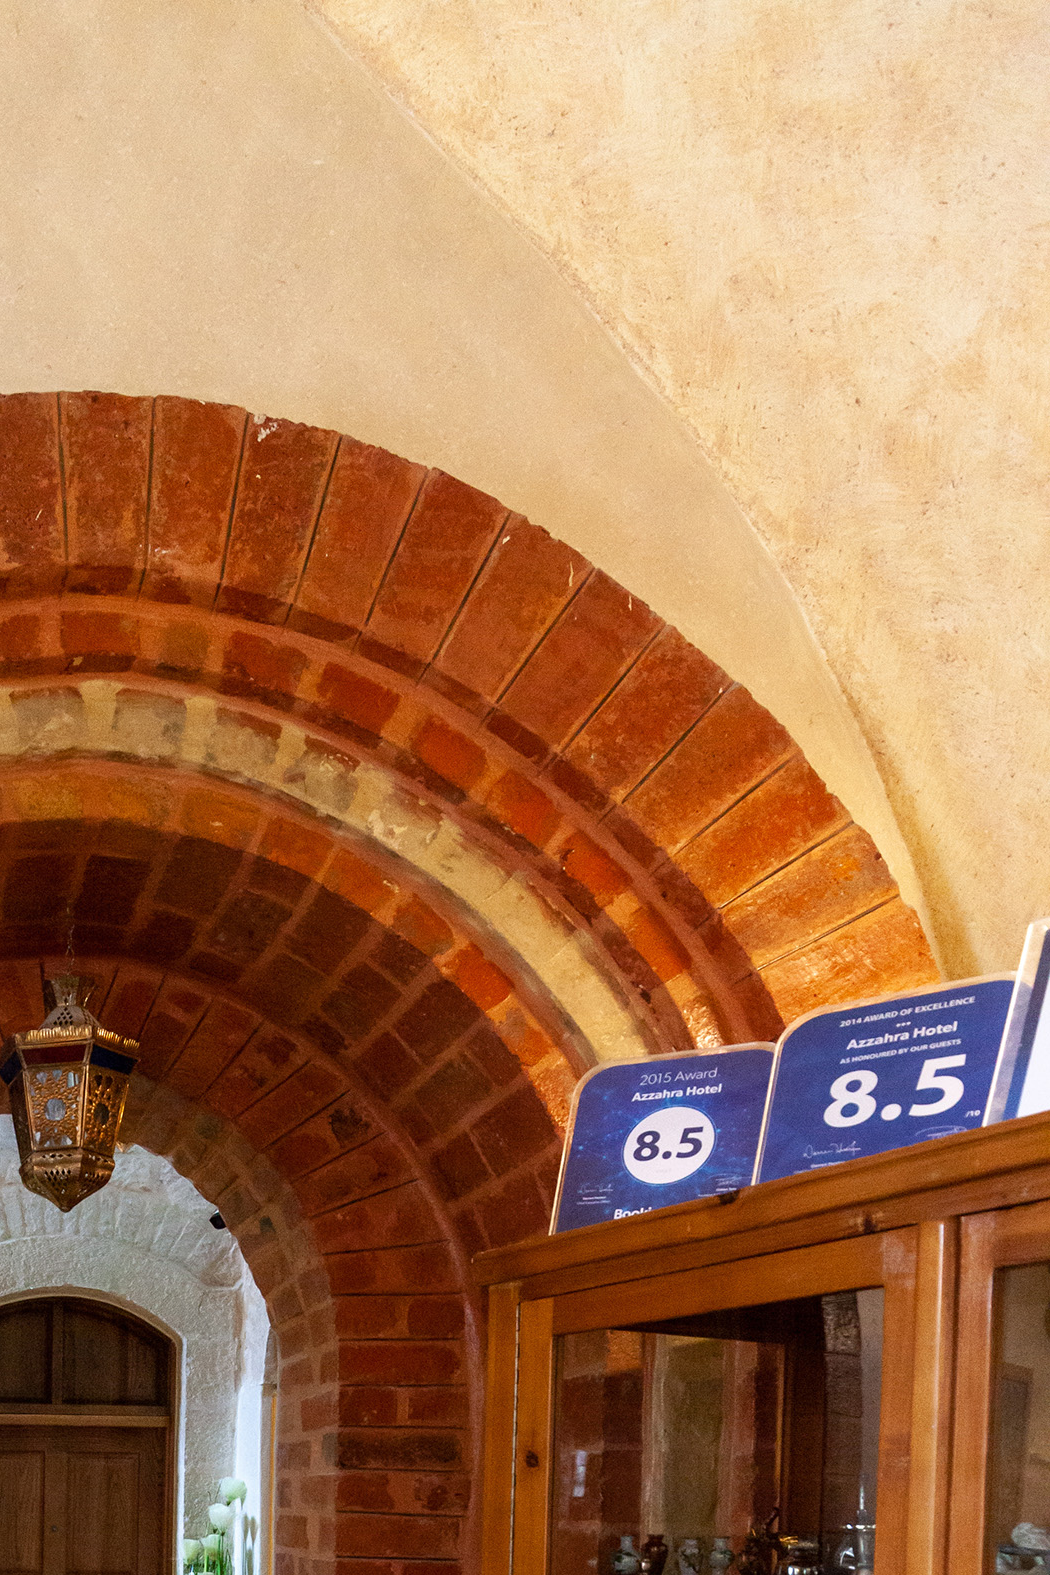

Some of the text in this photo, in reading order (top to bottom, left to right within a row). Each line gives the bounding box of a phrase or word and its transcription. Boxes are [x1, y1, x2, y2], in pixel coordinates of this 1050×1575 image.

[839, 996, 976, 1028] 2014 AWARD OF EXCELLENCE
[846, 1021, 958, 1050] Azzahra Hotel
[839, 1038, 962, 1065] AS HONOURED BY OUR GUESTS
[639, 1067, 718, 1086] 2015 Award
[631, 1083, 723, 1102] Azzahra Hotel
[823, 1054, 967, 1128] 8.5
[964, 1109, 981, 1119] /10
[633, 1126, 704, 1162] 8.5
